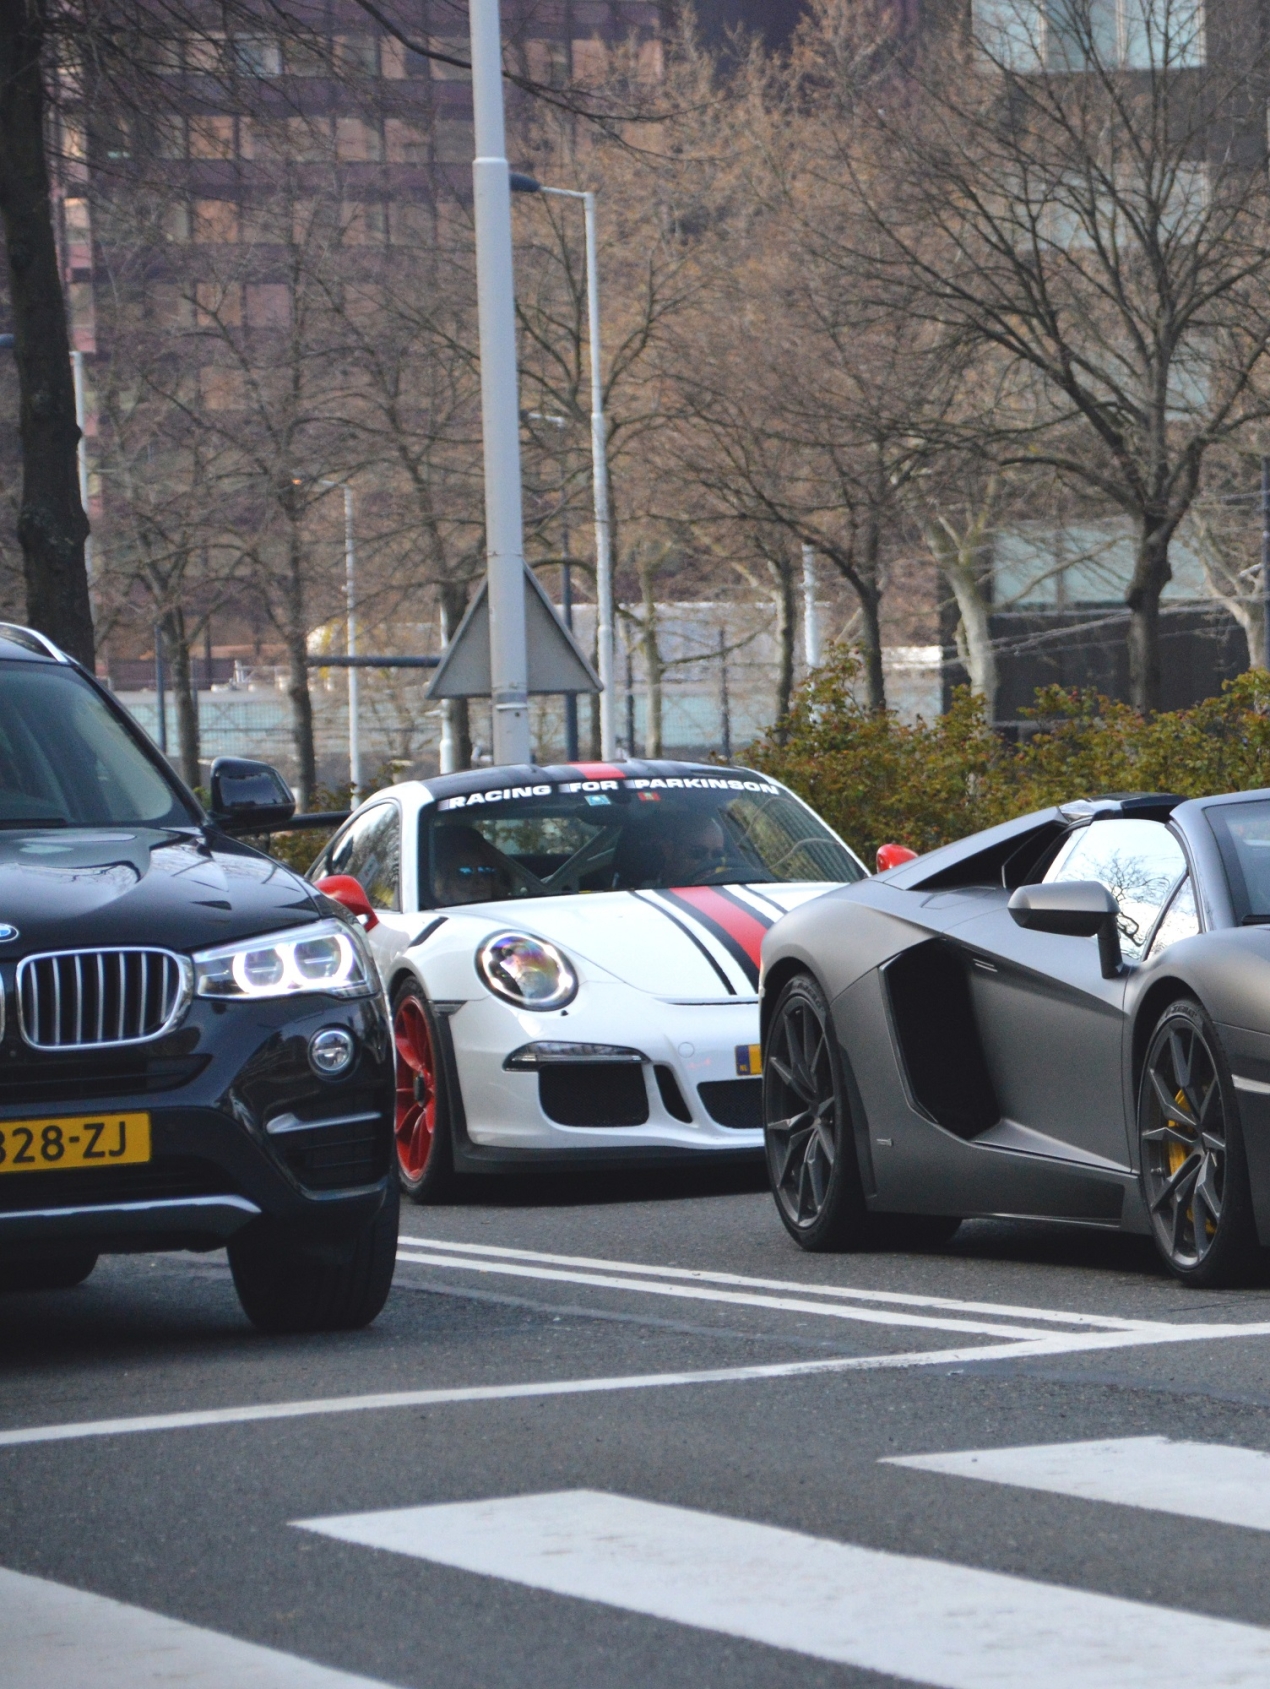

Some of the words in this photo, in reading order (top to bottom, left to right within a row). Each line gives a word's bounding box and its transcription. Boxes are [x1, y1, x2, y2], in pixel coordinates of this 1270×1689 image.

[448, 785, 552, 808] RACING
[568, 780, 619, 793] FOR
[634, 778, 780, 796] PARKINSON
